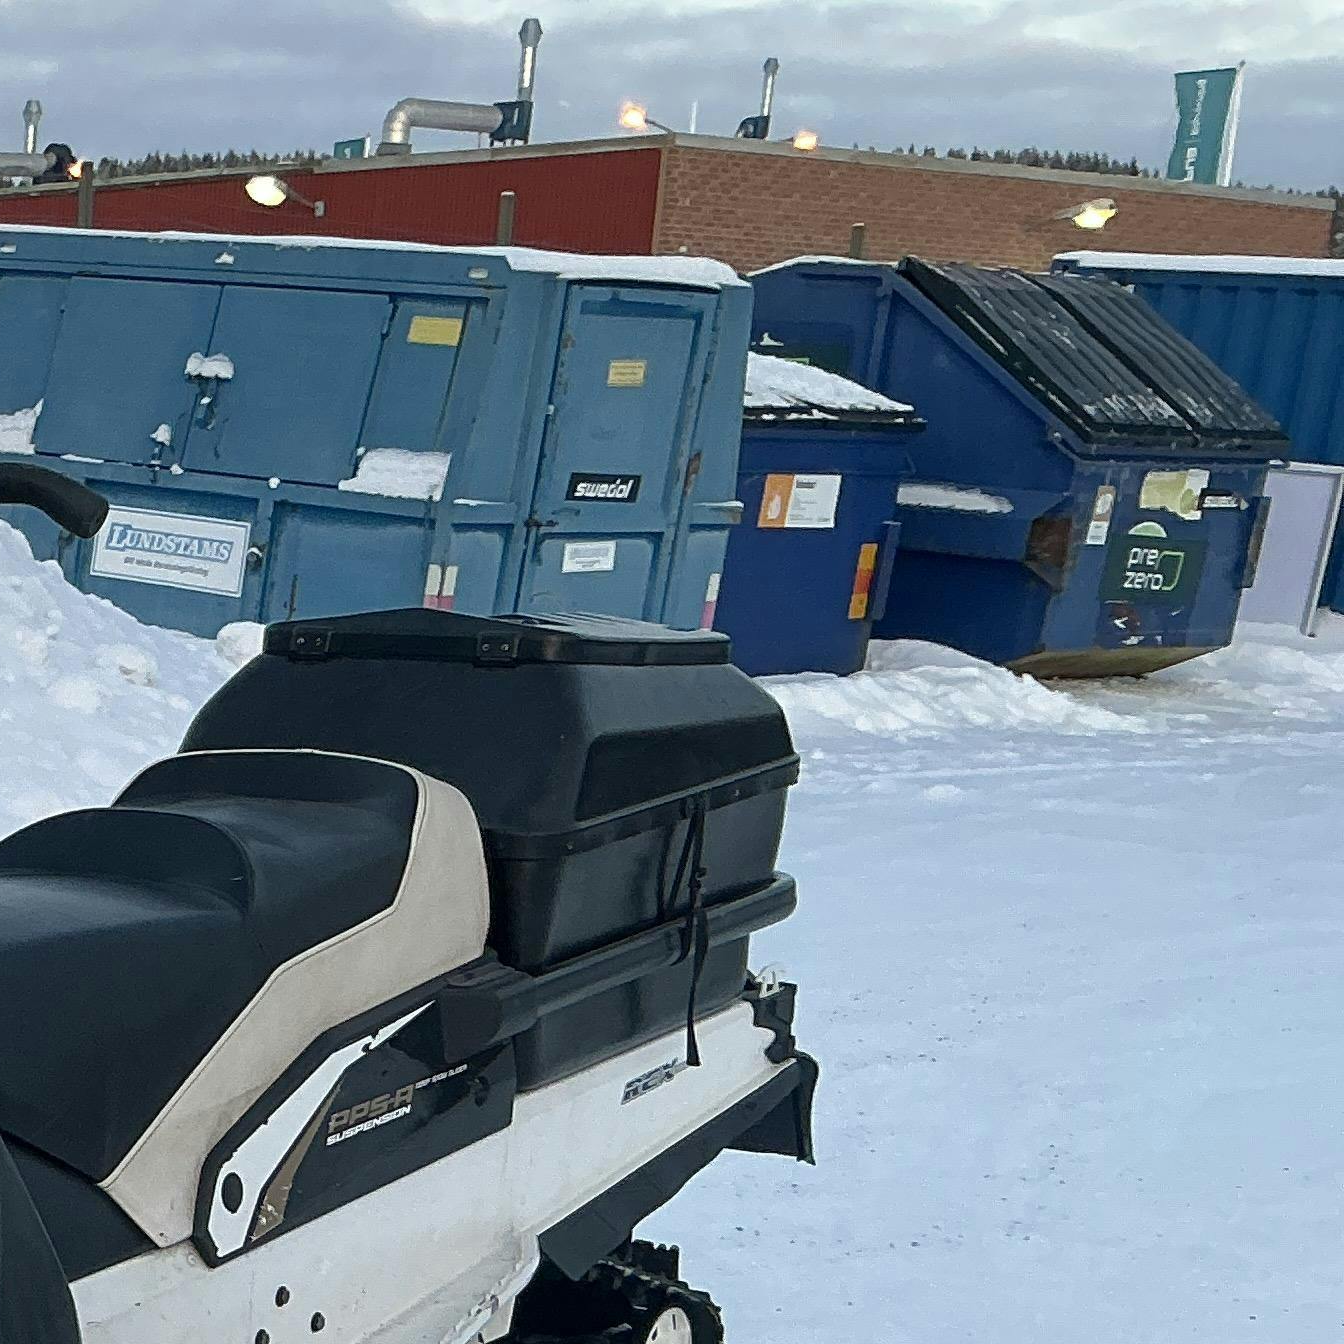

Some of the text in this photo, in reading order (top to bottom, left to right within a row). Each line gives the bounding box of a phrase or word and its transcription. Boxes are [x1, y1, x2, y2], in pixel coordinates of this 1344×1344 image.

[574, 478, 634, 499] swedol
[109, 524, 232, 562] LUNDSTAMS
[1127, 548, 1159, 570] pre
[1123, 571, 1163, 591] zero
[325, 1104, 412, 1146] SUSPENSION
